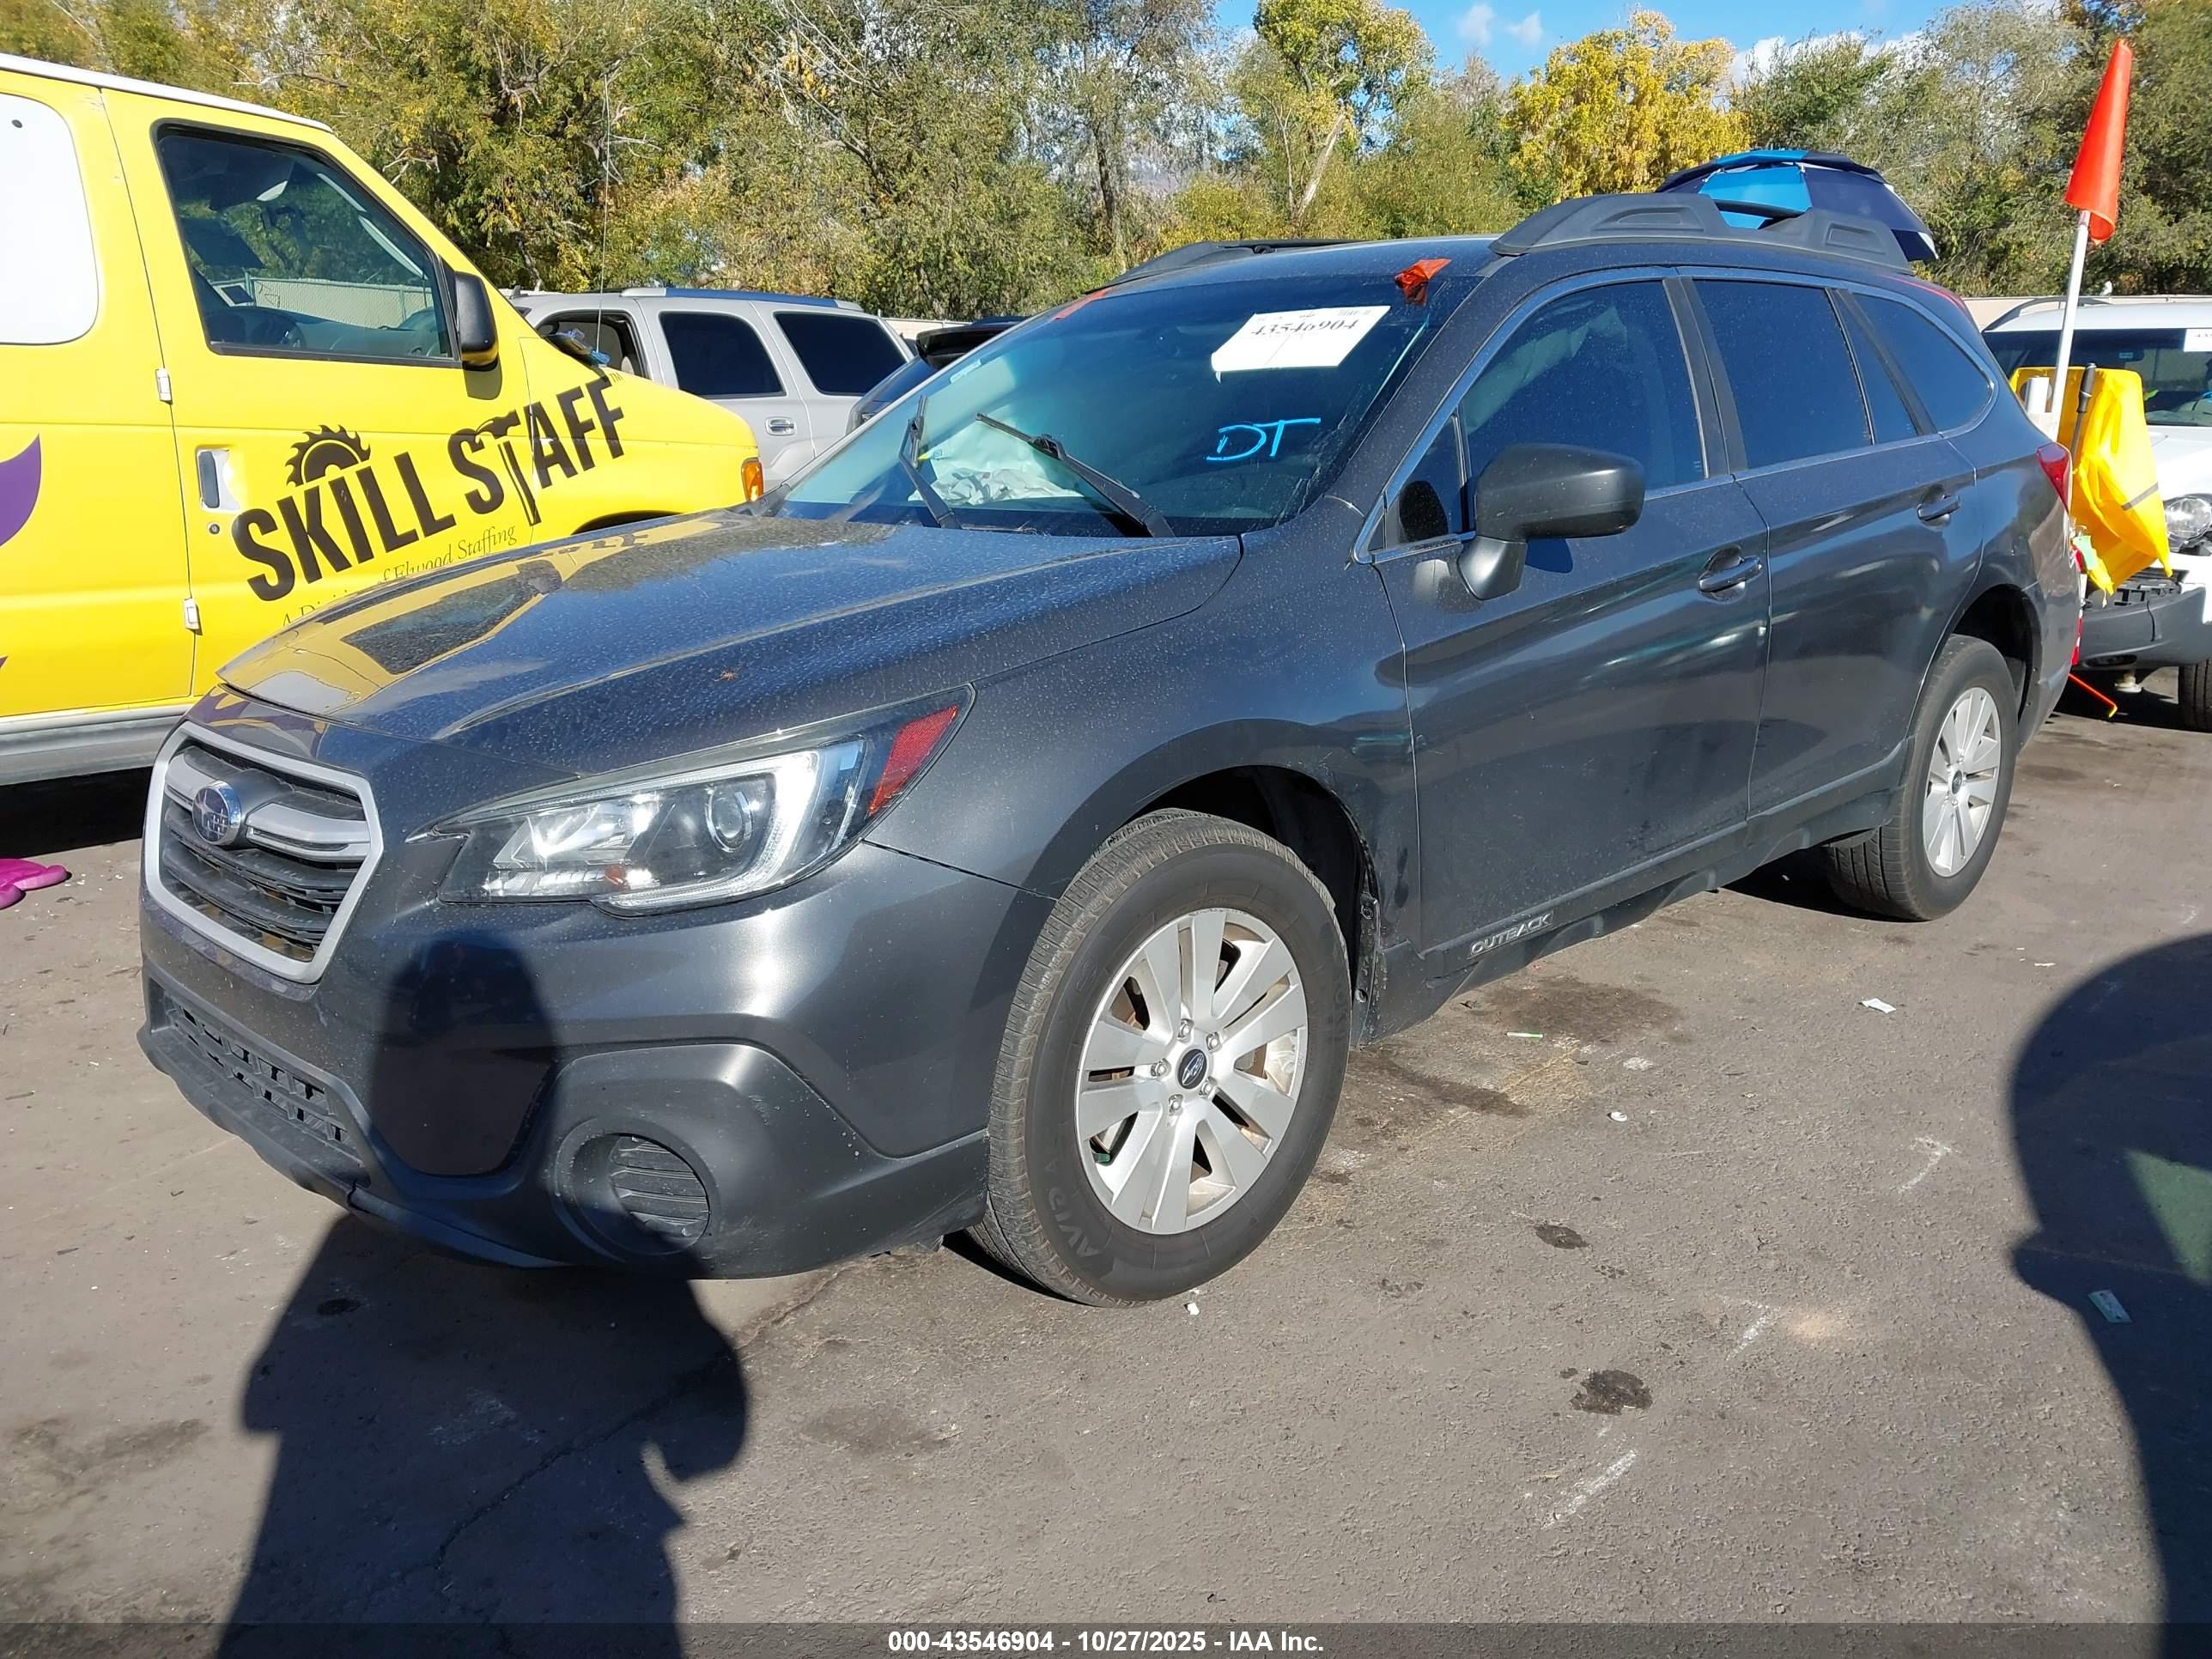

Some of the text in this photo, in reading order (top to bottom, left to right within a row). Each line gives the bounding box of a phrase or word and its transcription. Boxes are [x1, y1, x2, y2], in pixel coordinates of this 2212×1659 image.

[1206, 417, 1322, 461] DT
[231, 378, 625, 602] SKILL STAFF
[457, 525, 518, 560] Staffing
[1469, 912, 1554, 956] OUTBACK
